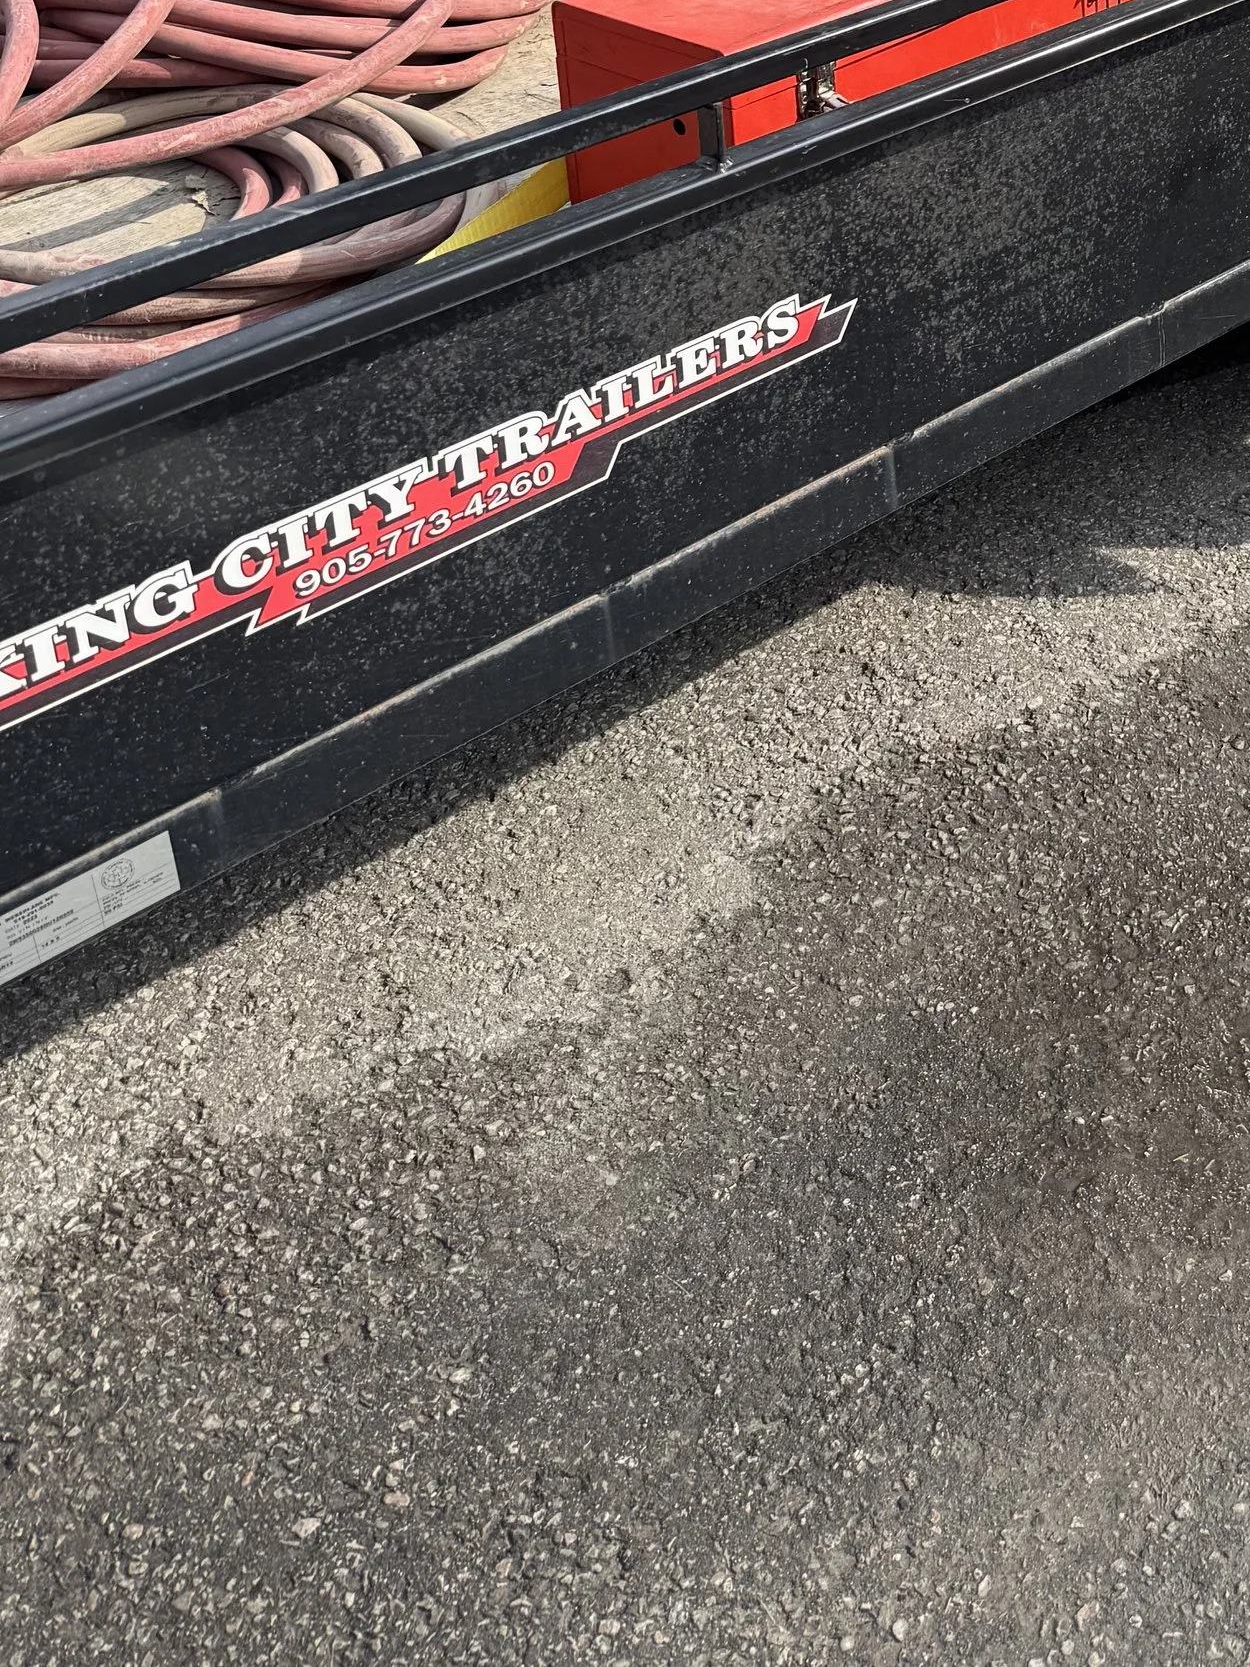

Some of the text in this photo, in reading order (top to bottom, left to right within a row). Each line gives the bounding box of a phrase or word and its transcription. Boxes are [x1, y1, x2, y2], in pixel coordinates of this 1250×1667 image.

[216, 465, 423, 593] CITY
[444, 300, 800, 491] TRAILERS
[295, 461, 556, 598] 905-773-4260
